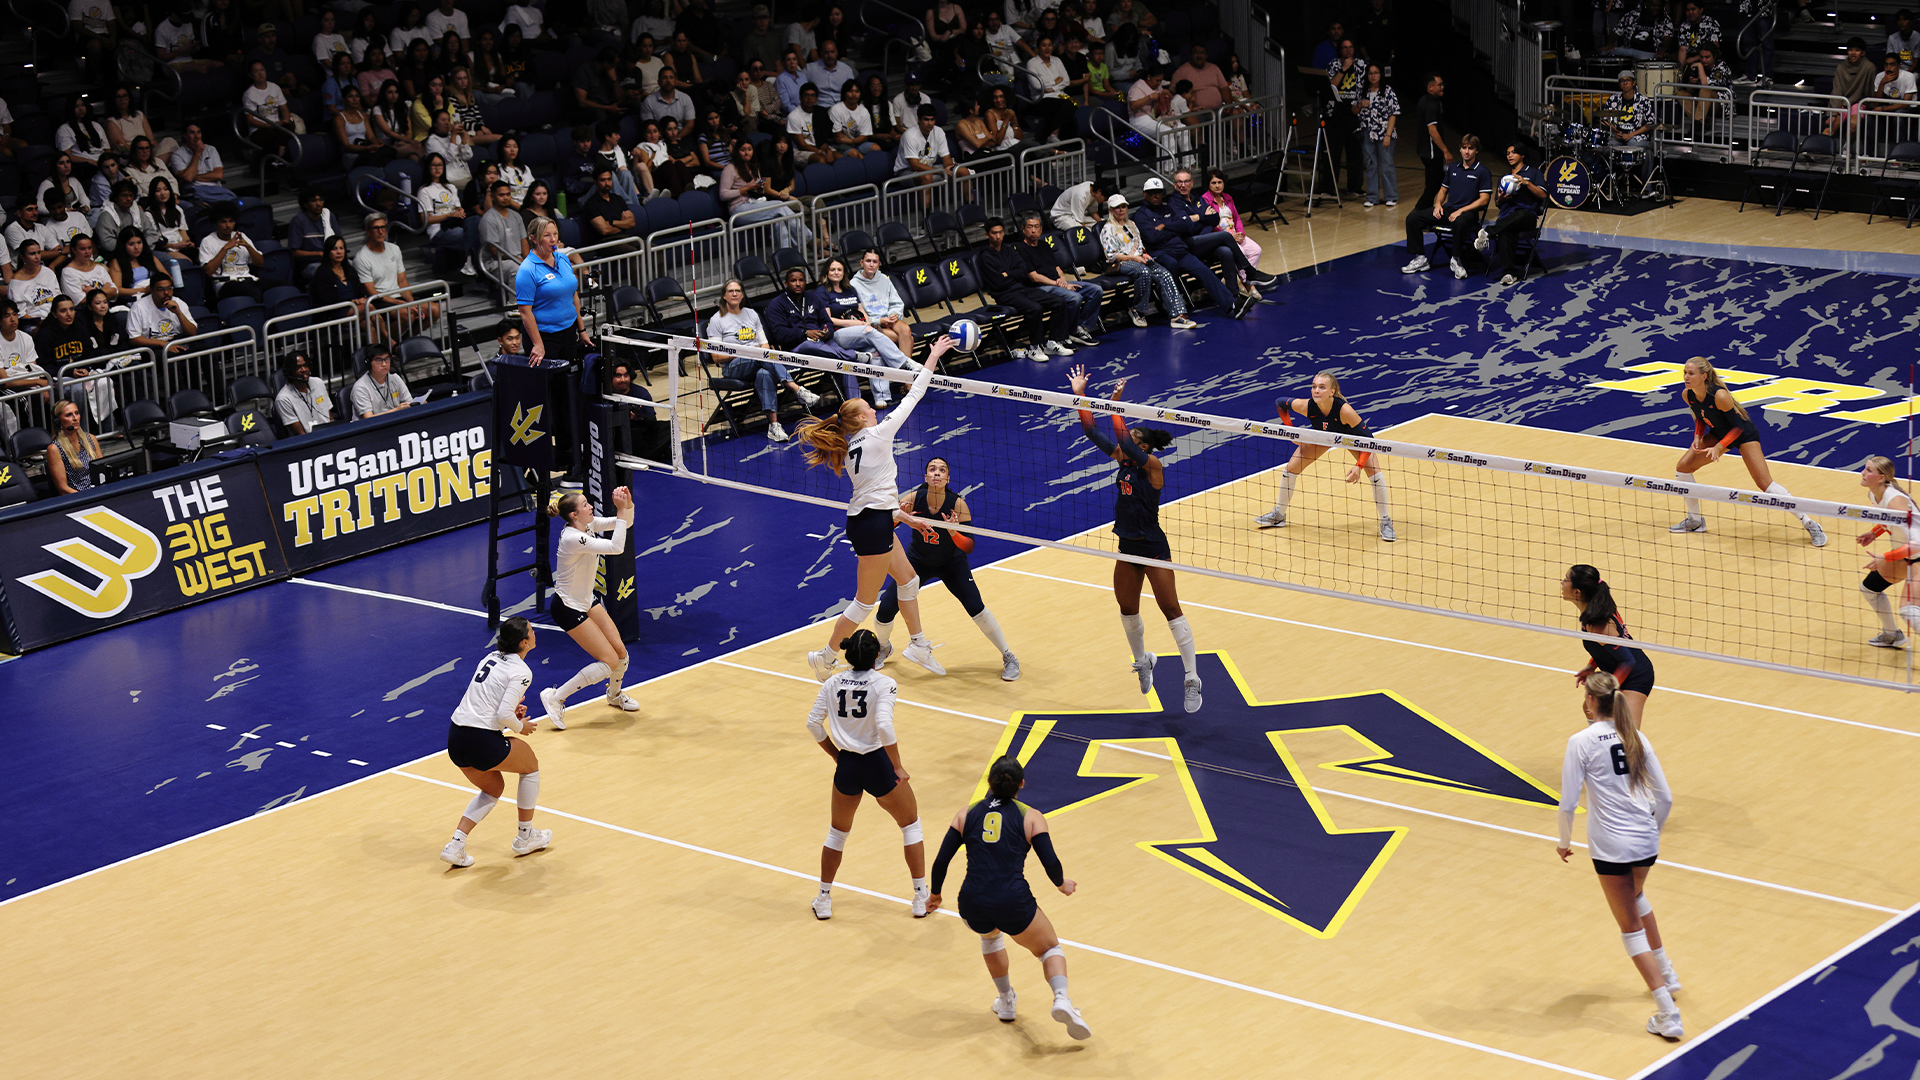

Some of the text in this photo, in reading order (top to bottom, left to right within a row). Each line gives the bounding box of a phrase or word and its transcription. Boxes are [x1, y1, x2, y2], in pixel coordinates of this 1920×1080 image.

[54, 340, 83, 359] UCSD
[849, 446, 862, 474] 7
[152, 474, 229, 522] THE
[284, 449, 501, 547] TRITONS
[165, 512, 233, 561] BIG
[923, 530, 939, 545] 12
[174, 541, 267, 597] WEST
[474, 659, 498, 683] 5
[840, 678, 869, 686] TRITONS
[837, 689, 868, 718] 13
[1610, 743, 1630, 775] 6
[982, 811, 1003, 843] 9
